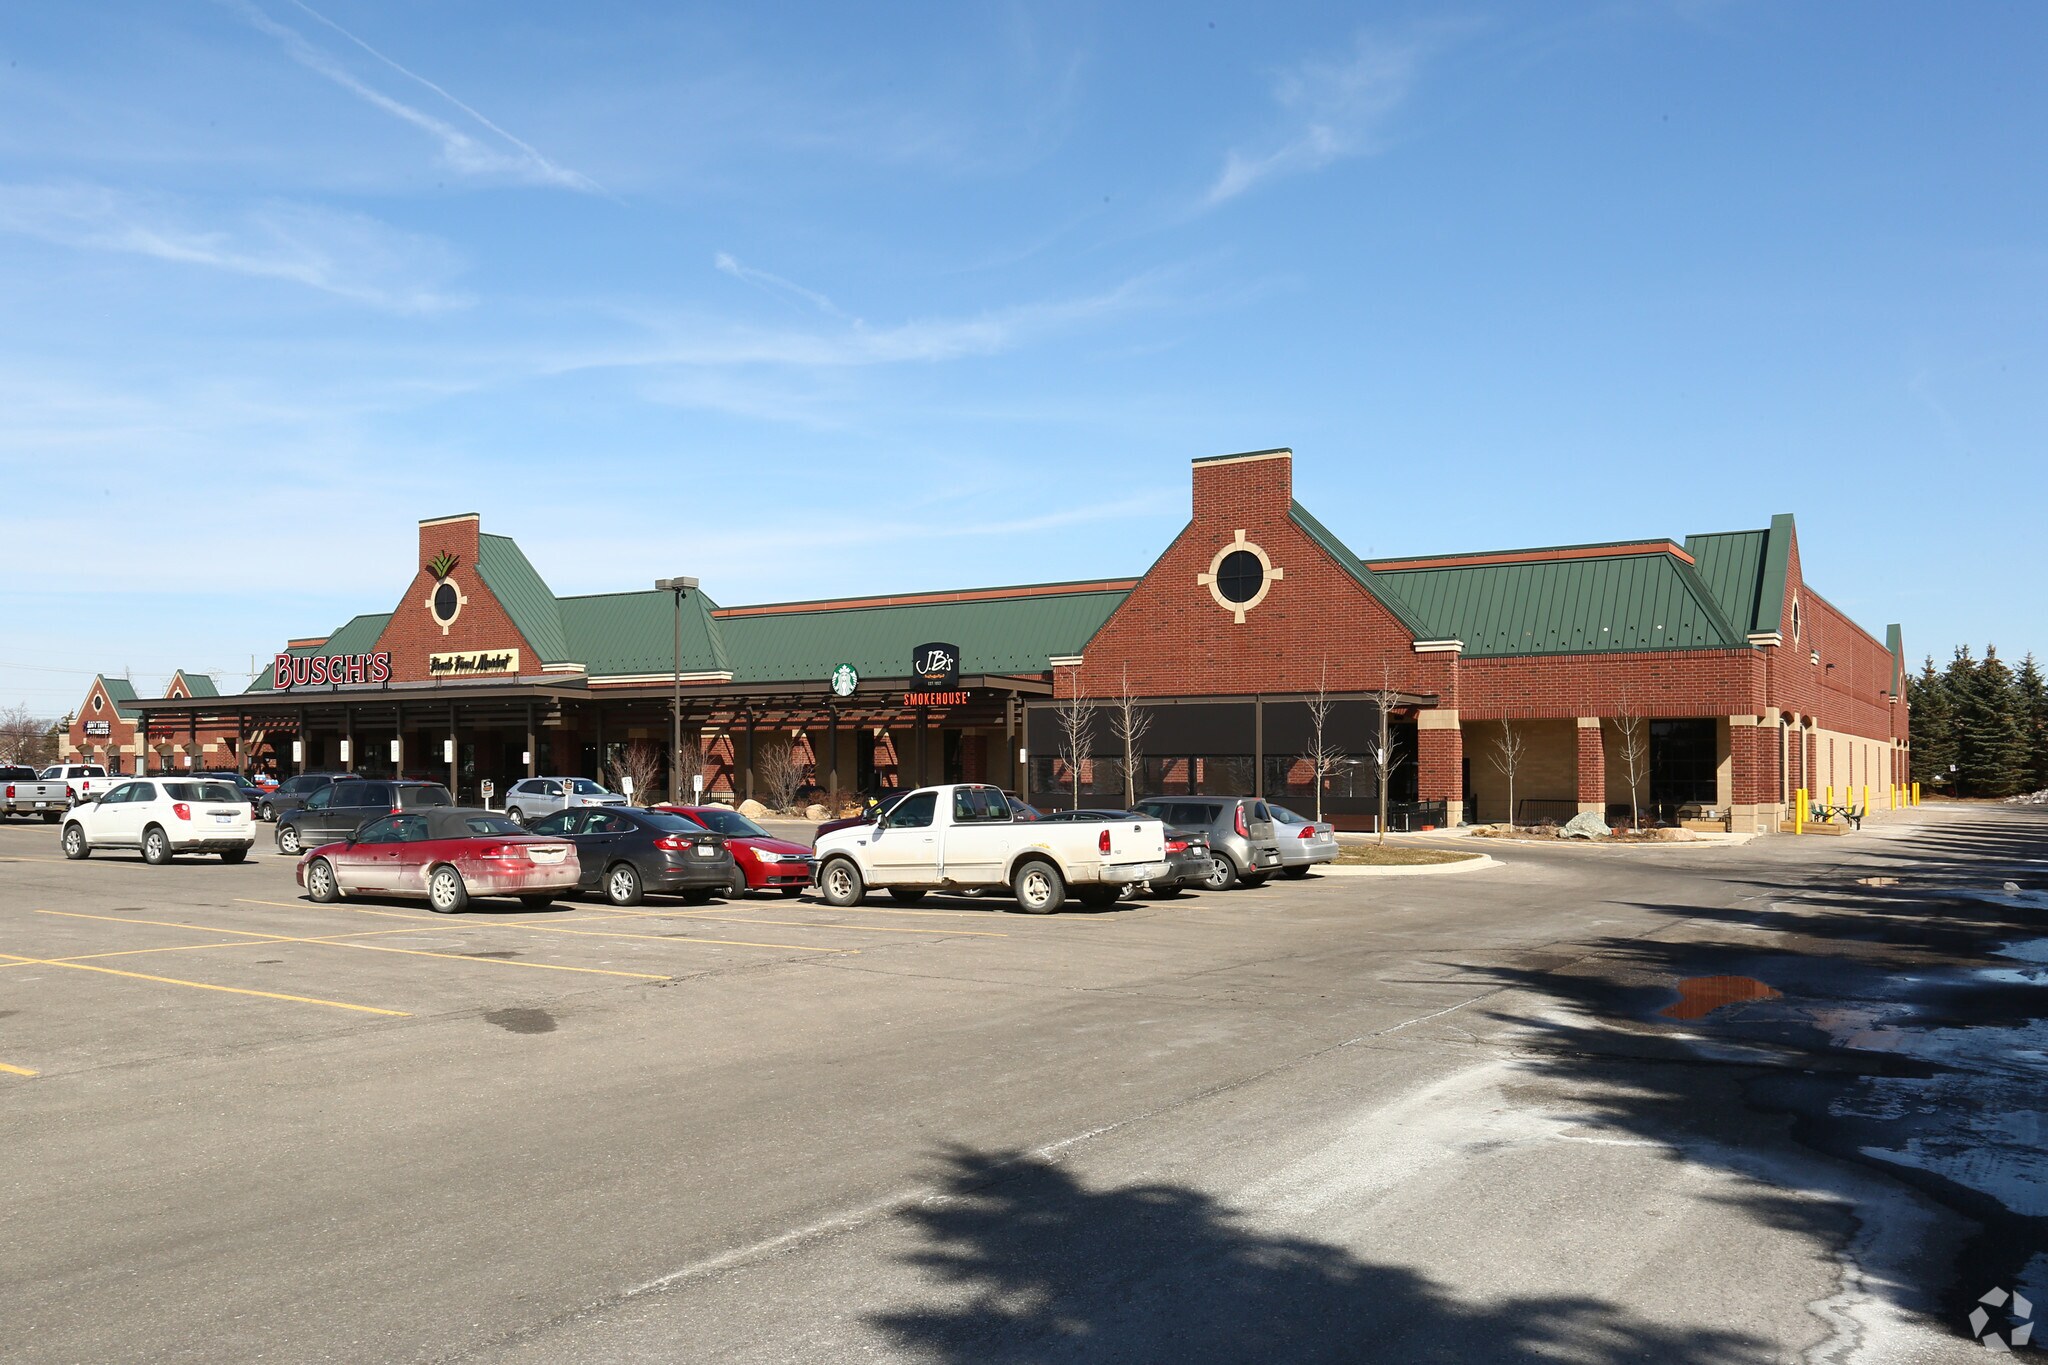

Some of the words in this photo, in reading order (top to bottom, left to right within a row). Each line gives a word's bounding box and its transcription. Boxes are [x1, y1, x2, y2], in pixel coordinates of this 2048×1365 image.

[273, 652, 390, 690] BUSCH'S
[454, 655, 477, 672] Food
[475, 653, 513, 671] Market
[903, 692, 967, 706] SMOKEHOUSE
